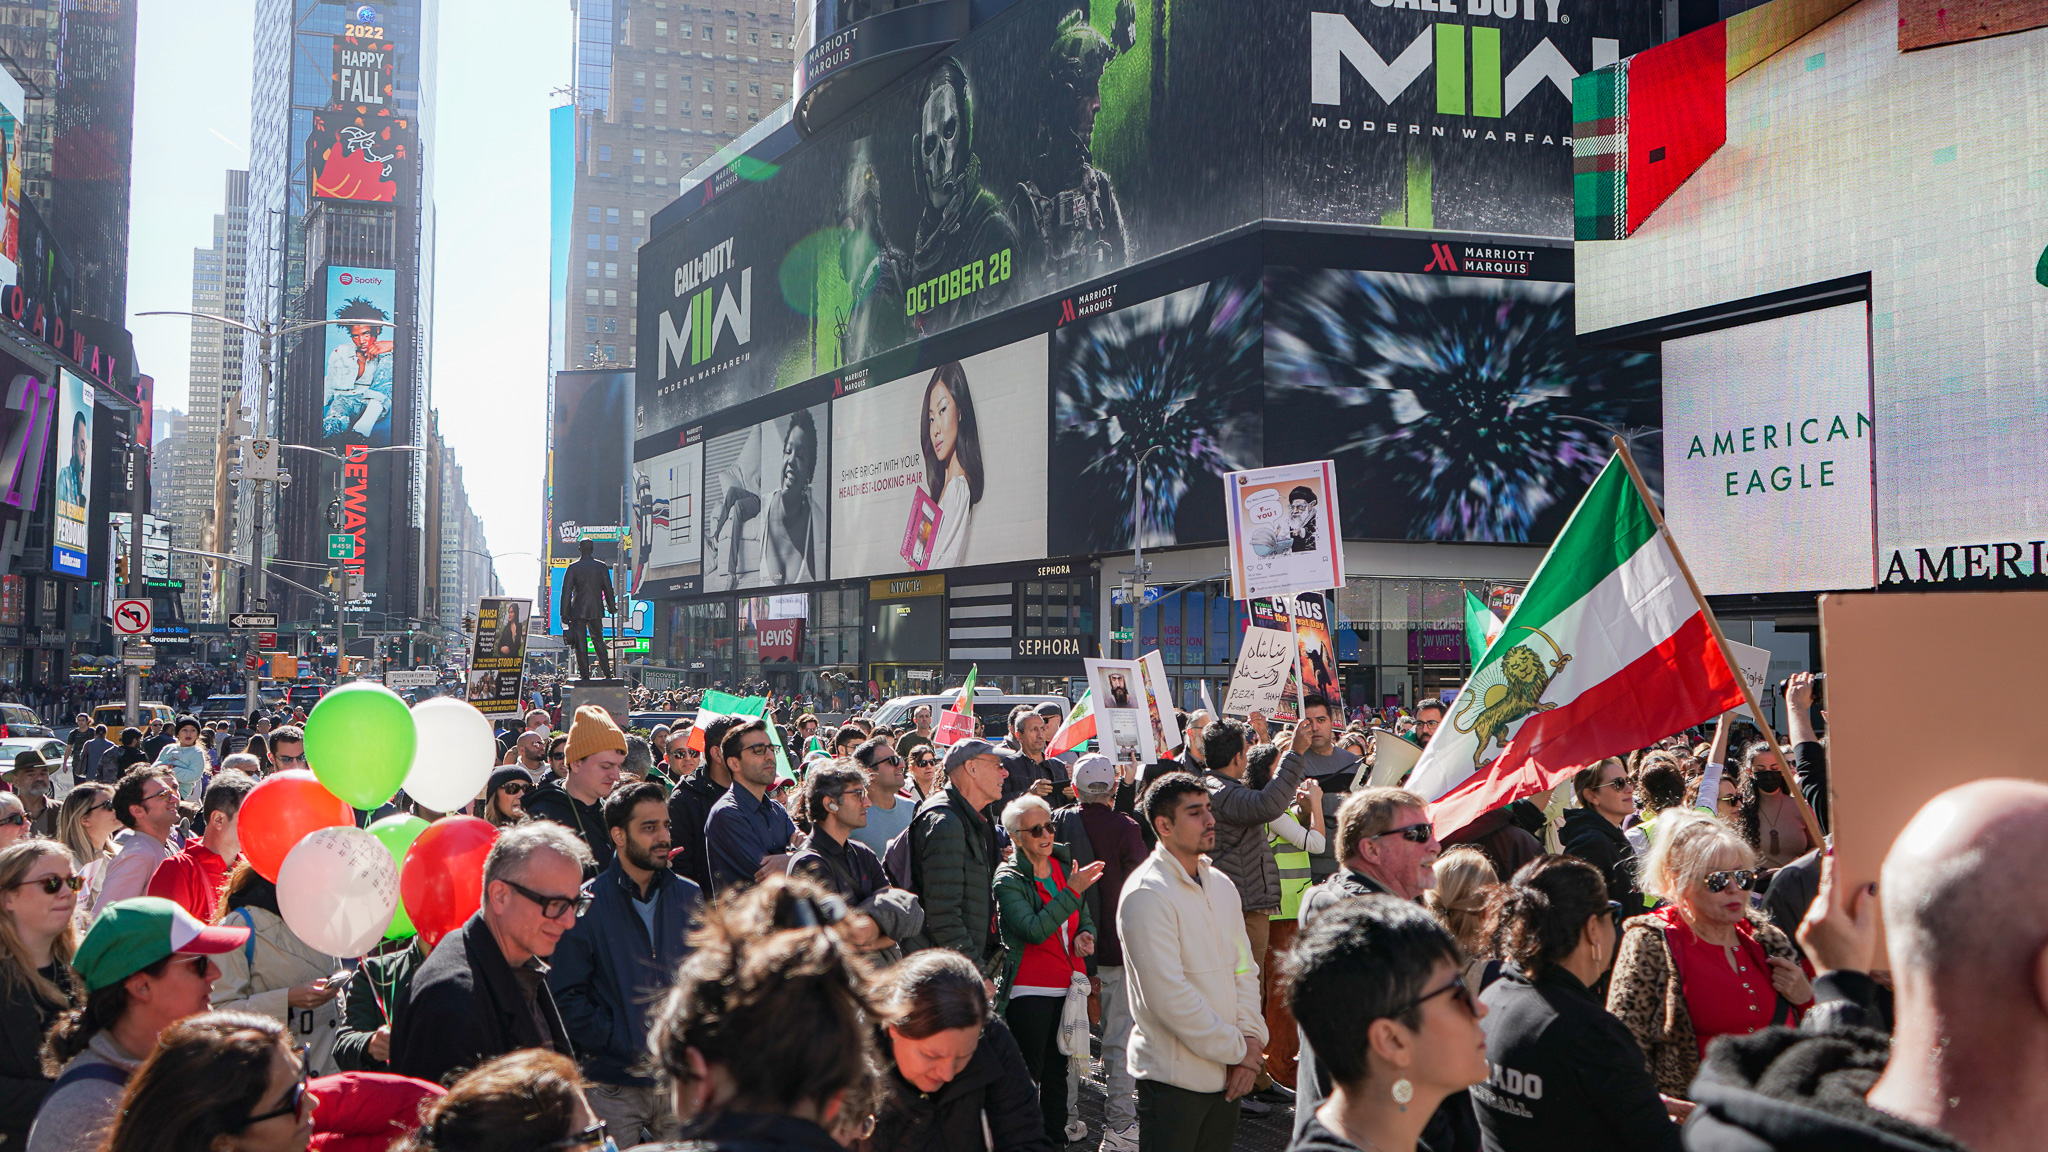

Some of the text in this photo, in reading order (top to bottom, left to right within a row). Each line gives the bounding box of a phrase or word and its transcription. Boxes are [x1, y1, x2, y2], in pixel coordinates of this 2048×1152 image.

[345, 23, 384, 40] 2022
[809, 28, 858, 65] MARRIOTT
[341, 50, 384, 69] HAPPY
[809, 48, 850, 81] MARQUIS
[340, 68, 384, 105] FALL
[1312, 116, 1445, 137] MODERN
[715, 158, 742, 183] MARRIOTT
[715, 173, 738, 194] MARQUIS
[1465, 247, 1535, 261] MARRIOTT
[1465, 261, 1527, 274] MARQUIS
[354, 276, 383, 286] Spotify
[674, 257, 700, 298] CALL
[906, 247, 1011, 317] OCTOBER 28
[1078, 284, 1118, 305] MARRIOTT
[1078, 298, 1113, 317] MARQUIS
[844, 368, 869, 383] MARRIOTT
[657, 375, 695, 397] MODERN
[844, 379, 866, 392] MARQUIS
[686, 425, 703, 436] MARRIOTT
[1687, 411, 1871, 460] AMERICAN
[686, 434, 701, 443] MARQUIS
[126, 452, 134, 491] 1500
[841, 454, 920, 482] SHINE BRIGHT WITH YOUR
[838, 472, 923, 499] HEALTHIEST-LOOKING HAIR
[1726, 460, 1835, 497] EAGLE
[1257, 512, 1273, 520] YOU
[559, 526, 581, 538] LOUD
[1037, 565, 1070, 577] SEPHORA
[890, 579, 922, 594] INVICTA
[350, 604, 370, 612] Jeans
[479, 609, 498, 619] MAHSA
[1255, 606, 1273, 617] LIFE
[480, 619, 497, 629] AMINI
[1274, 613, 1324, 631] the reat Day
[1018, 639, 1080, 655] SEPHORA
[1141, 637, 1203, 647] CONNECION
[1435, 634, 1455, 646] WITH
[497, 658, 514, 668] STOOD
[645, 671, 676, 679] DISCOVER
[1229, 689, 1255, 700] REZA
